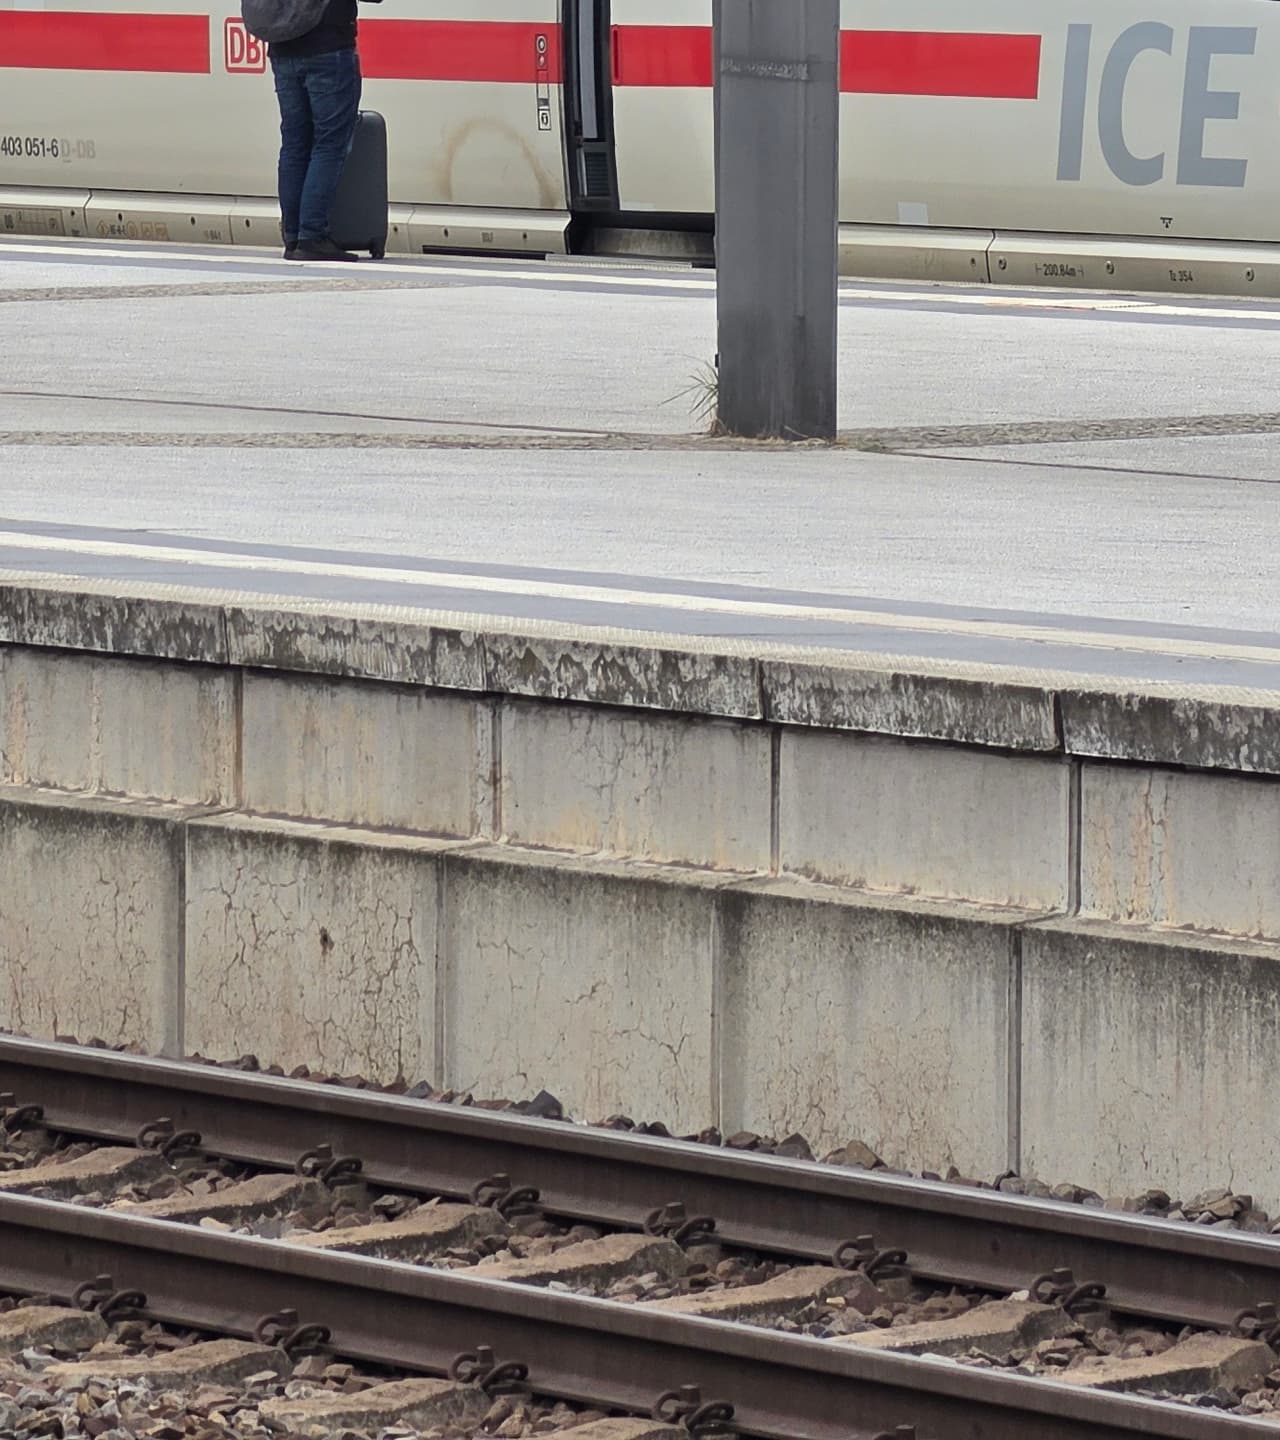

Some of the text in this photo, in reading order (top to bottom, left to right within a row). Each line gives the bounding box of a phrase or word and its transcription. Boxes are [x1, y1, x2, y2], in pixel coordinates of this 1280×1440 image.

[228, 25, 262, 65] DB
[1056, 21, 1258, 188] ICE
[0, 136, 23, 157] 403
[24, 137, 60, 158] 051-6
